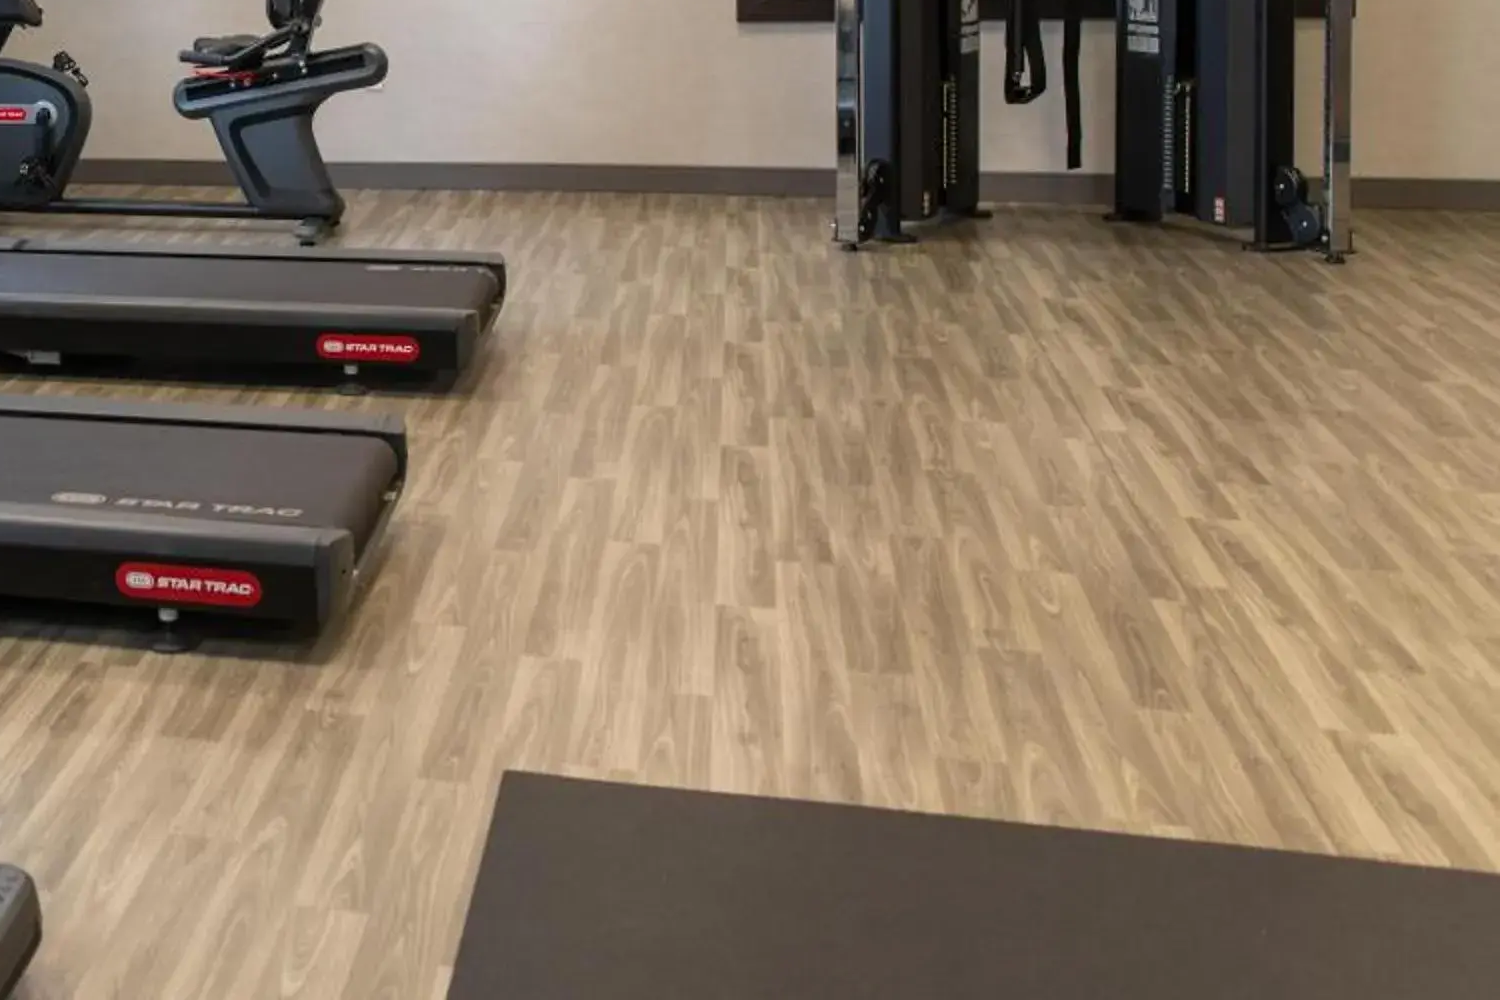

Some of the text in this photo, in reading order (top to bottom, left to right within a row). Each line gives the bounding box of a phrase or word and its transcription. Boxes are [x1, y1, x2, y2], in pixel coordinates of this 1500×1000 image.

[345, 343, 413, 353] STAR TRAC
[116, 498, 303, 517] STAR TRAC
[157, 575, 253, 596] STAR TRAC
